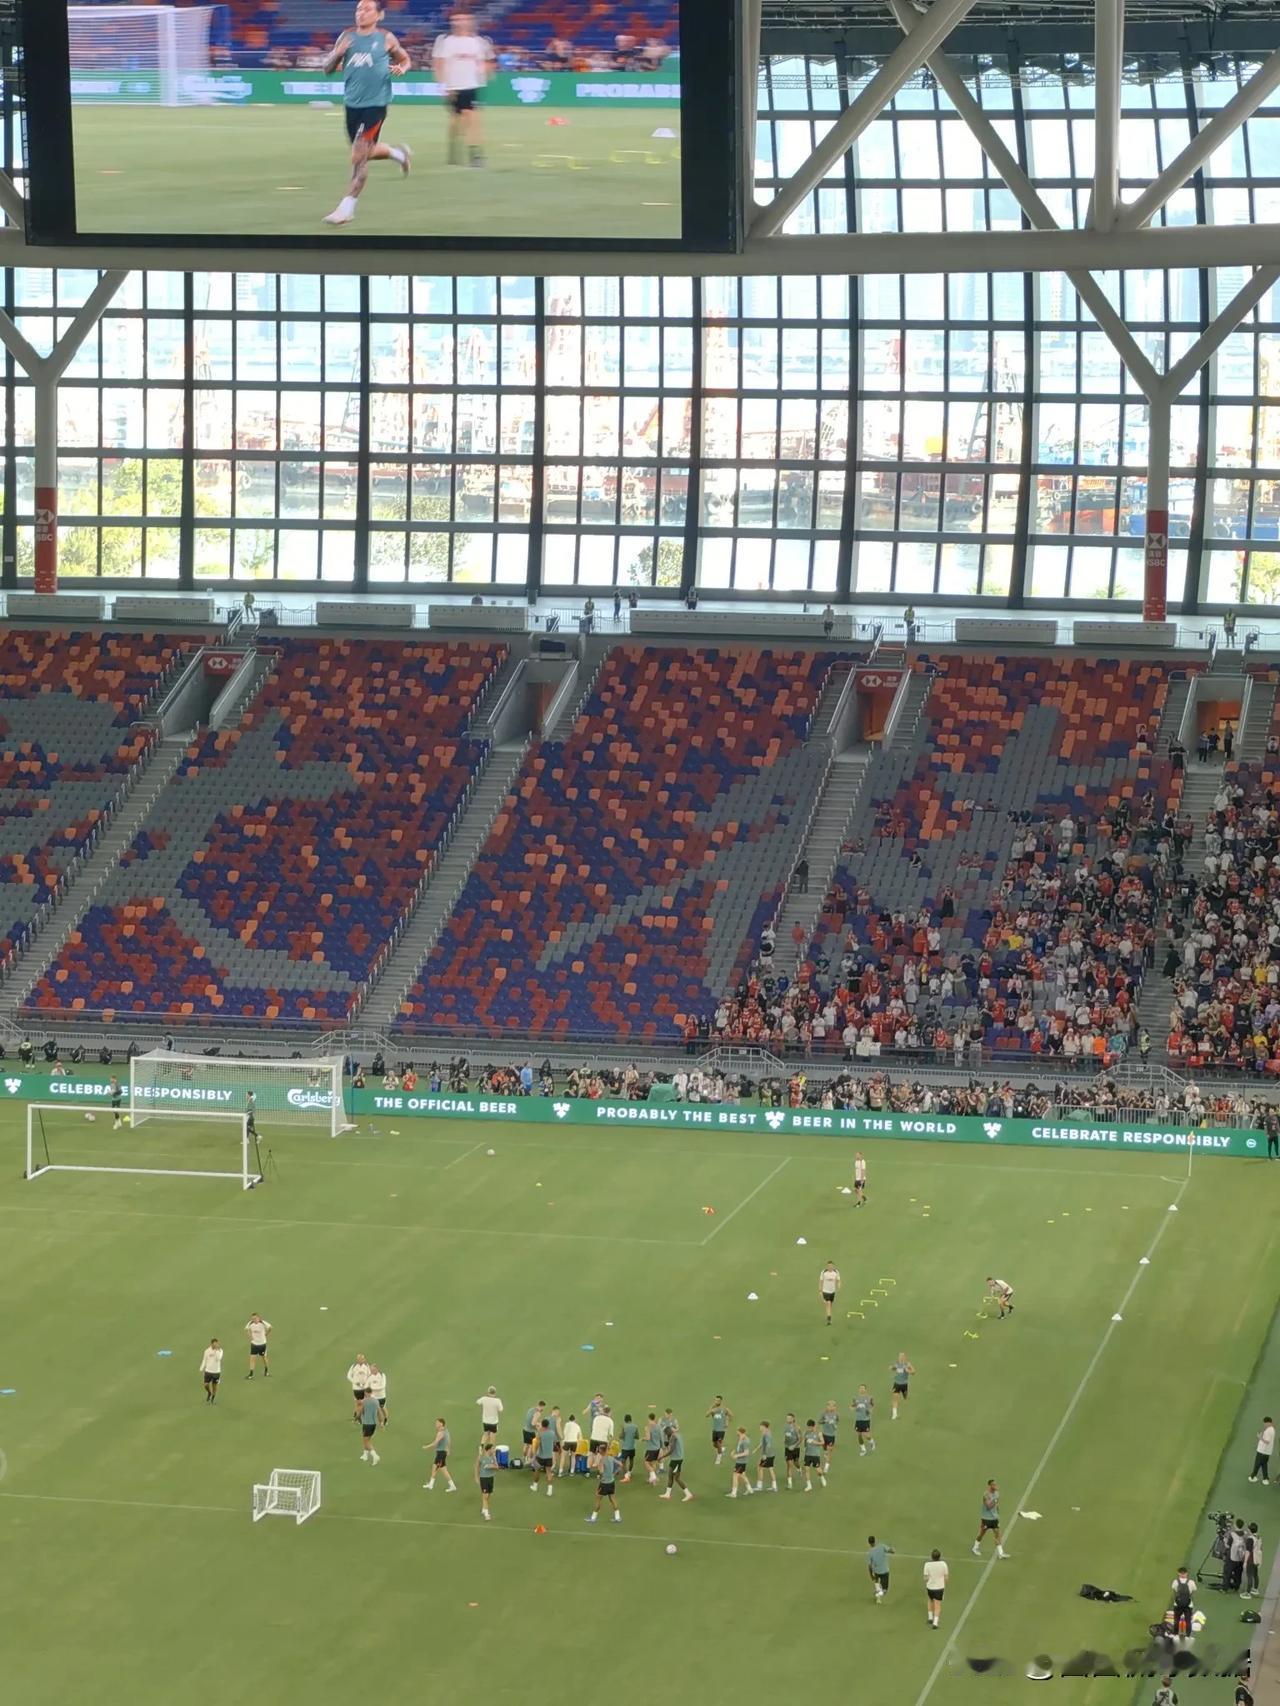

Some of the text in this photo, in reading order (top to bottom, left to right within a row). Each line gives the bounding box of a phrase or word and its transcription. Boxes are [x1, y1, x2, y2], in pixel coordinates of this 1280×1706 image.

[49, 1082, 233, 1101] CELEBRAE RESPONSIBLY
[374, 1096, 517, 1114] THE OFFICIAL BEER
[597, 1106, 757, 1125] PROBABLY THE BEST
[792, 1115, 957, 1134] BEER IN THE WORLD
[1032, 1127, 1231, 1148] CELEBRATE RESPONSIBLY
